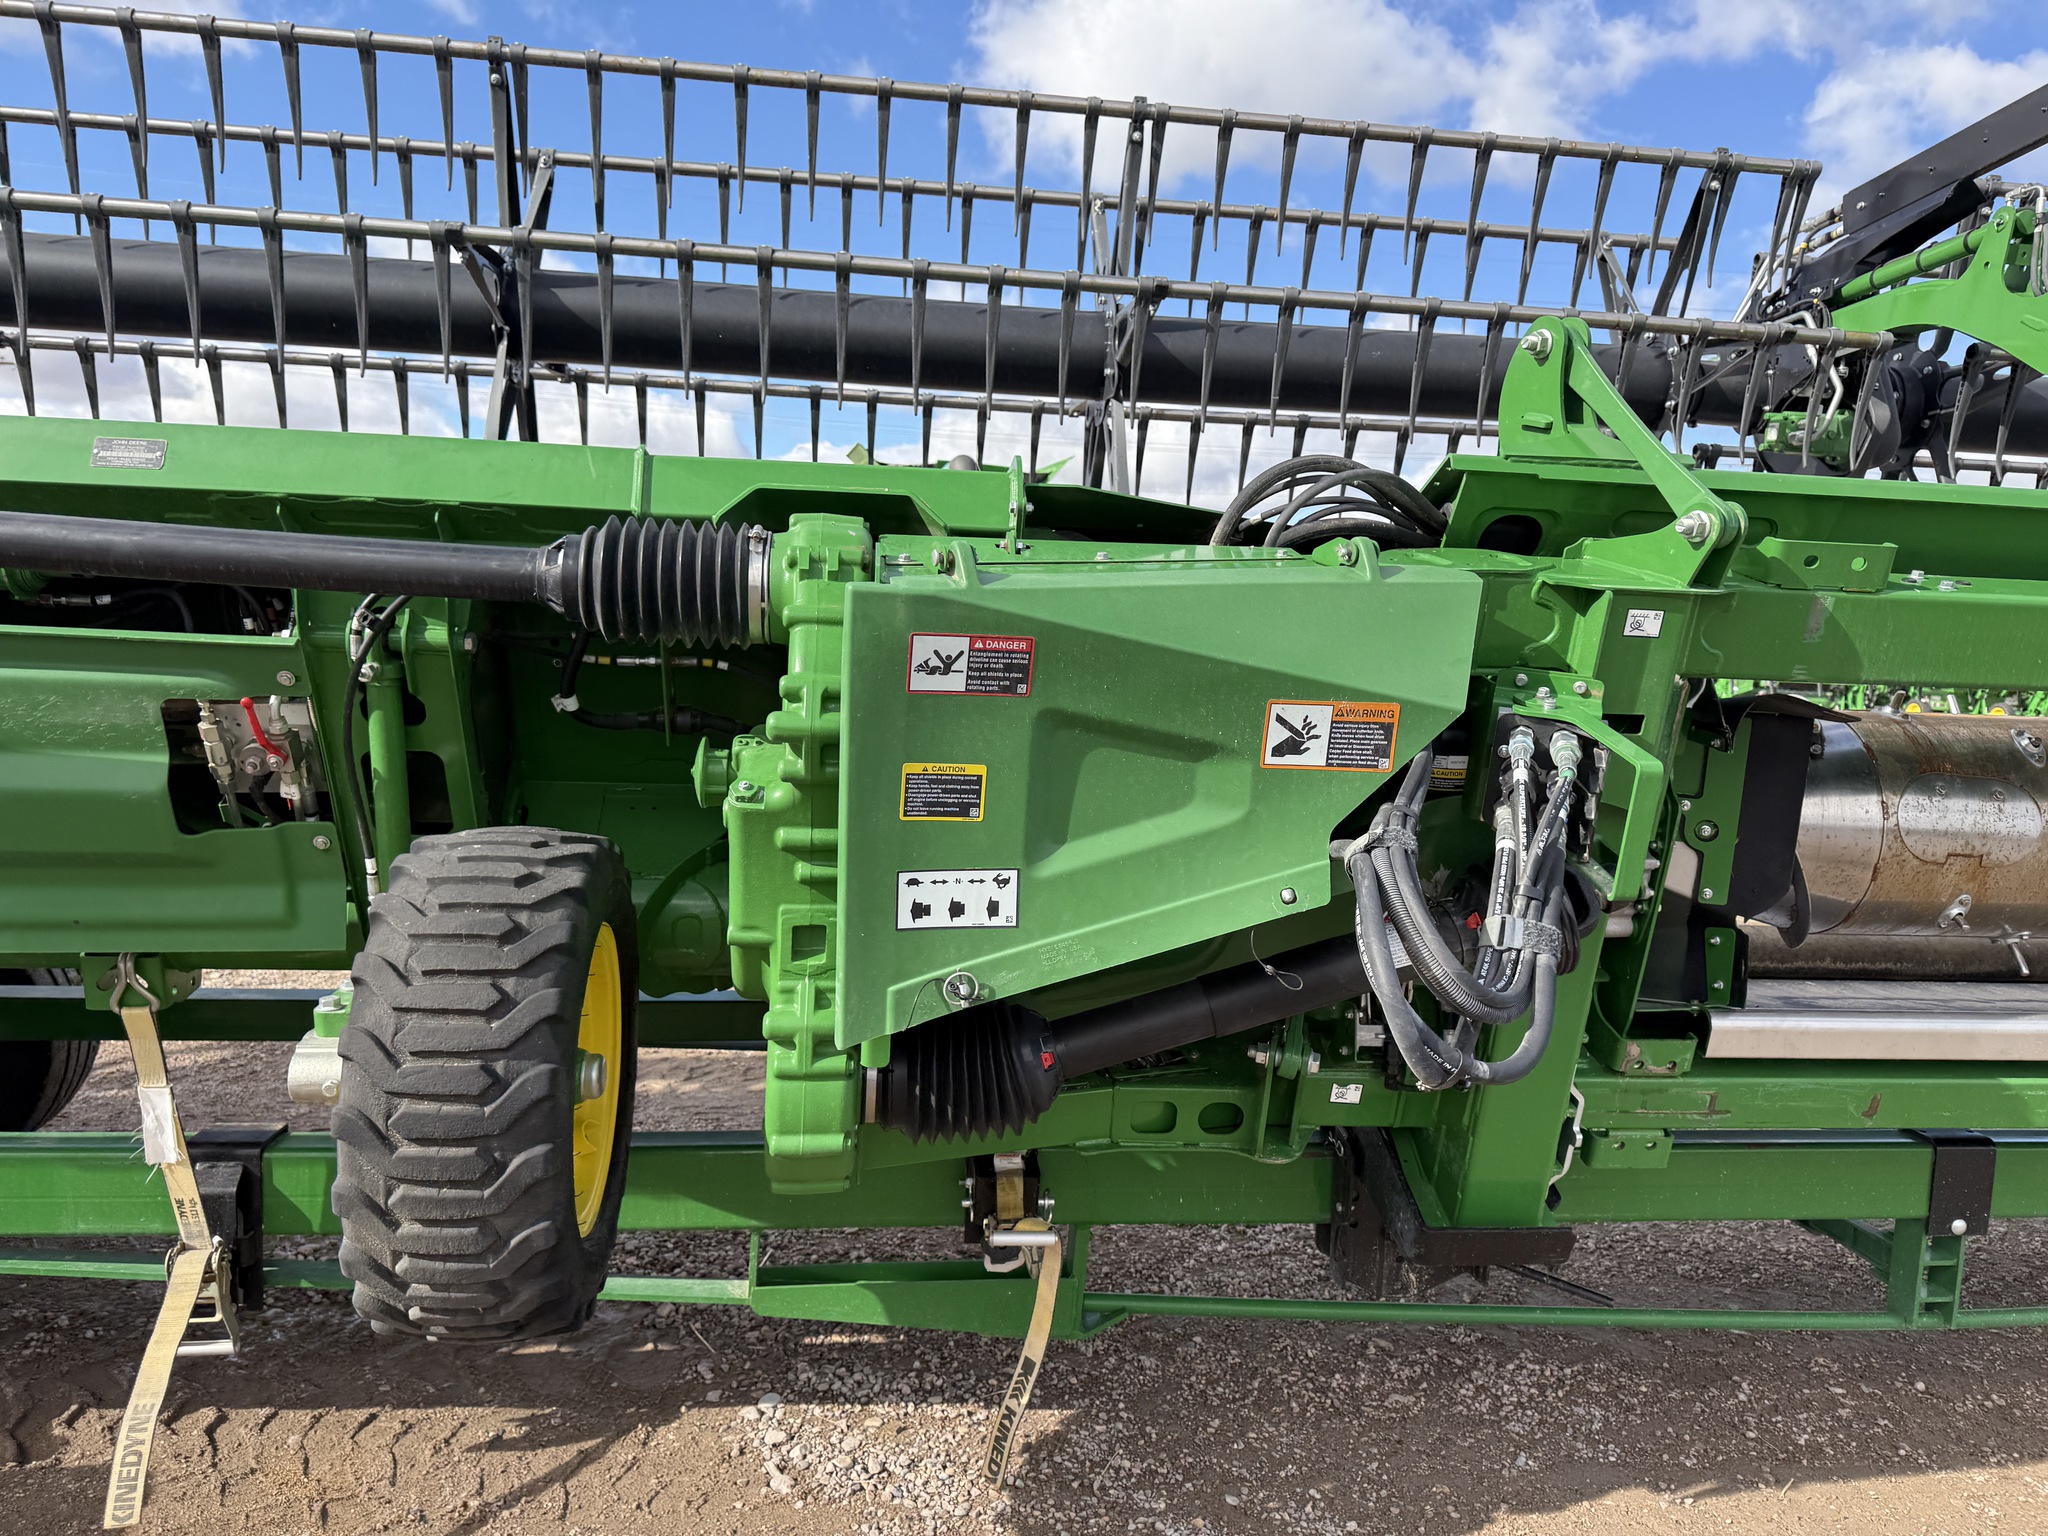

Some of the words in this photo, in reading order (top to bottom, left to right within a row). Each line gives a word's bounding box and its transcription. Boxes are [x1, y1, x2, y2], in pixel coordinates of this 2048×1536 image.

[986, 641, 1027, 649] DANGER
[1346, 709, 1395, 718] WARNING
[111, 1403, 156, 1527] KINEDYNE
